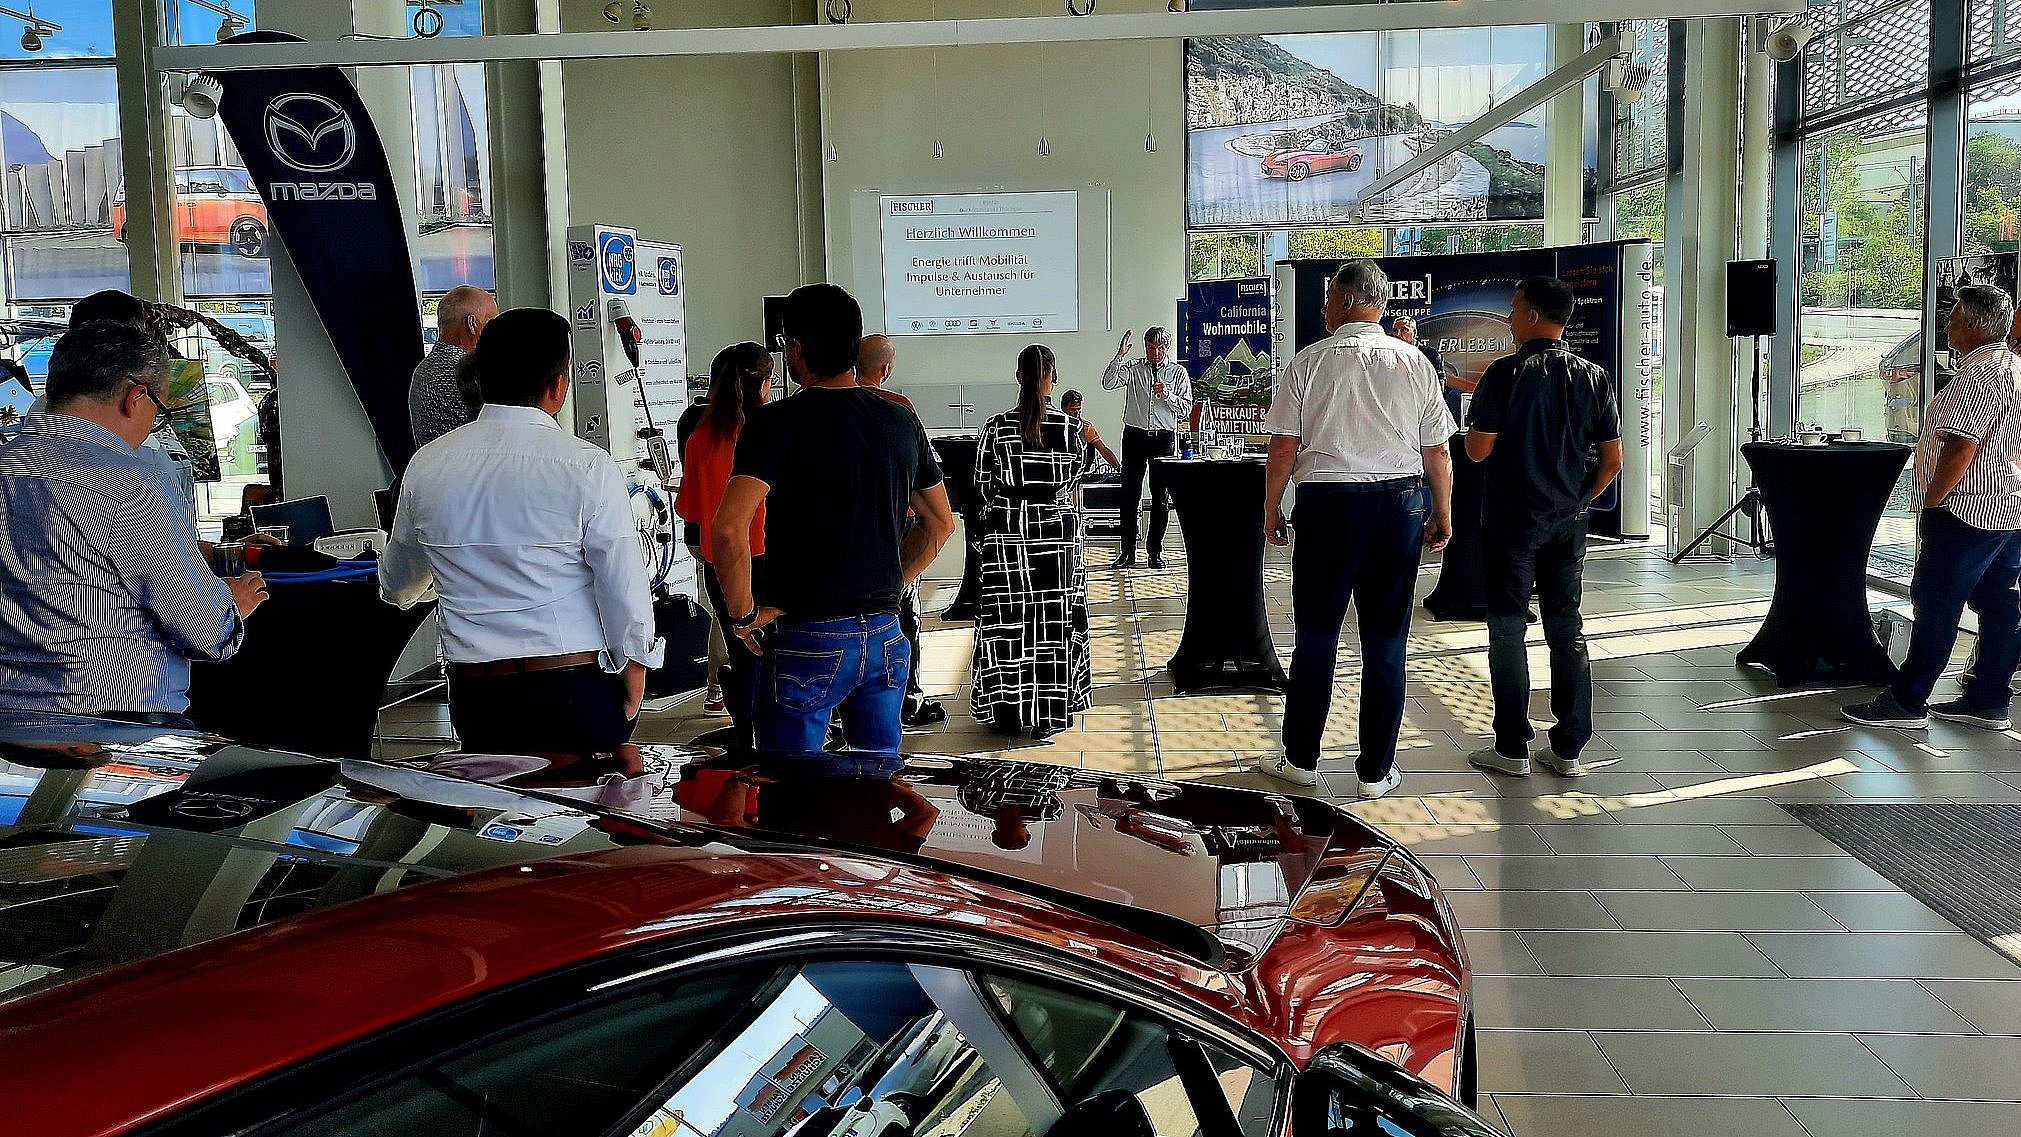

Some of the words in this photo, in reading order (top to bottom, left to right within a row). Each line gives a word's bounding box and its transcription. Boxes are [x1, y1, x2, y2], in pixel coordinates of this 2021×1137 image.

[270, 182, 377, 201] mazda
[905, 226, 956, 240] Herzlich
[958, 225, 1036, 238] Willkommen
[911, 256, 952, 270] Energie
[953, 255, 977, 267] trifft
[978, 253, 1029, 266] Mobilität
[905, 271, 949, 285] Impulse
[950, 271, 961, 282] &
[963, 270, 1017, 282] Austausch
[1019, 269, 1035, 280] für
[935, 285, 1007, 297] Unternehmer
[1220, 304, 1267, 318] California
[1203, 319, 1267, 335] Wohnmobile
[1438, 336, 1507, 353] ERLEBEN
[1635, 261, 1651, 447] www.fischer-auto.de
[1213, 406, 1258, 420] VERKAUF
